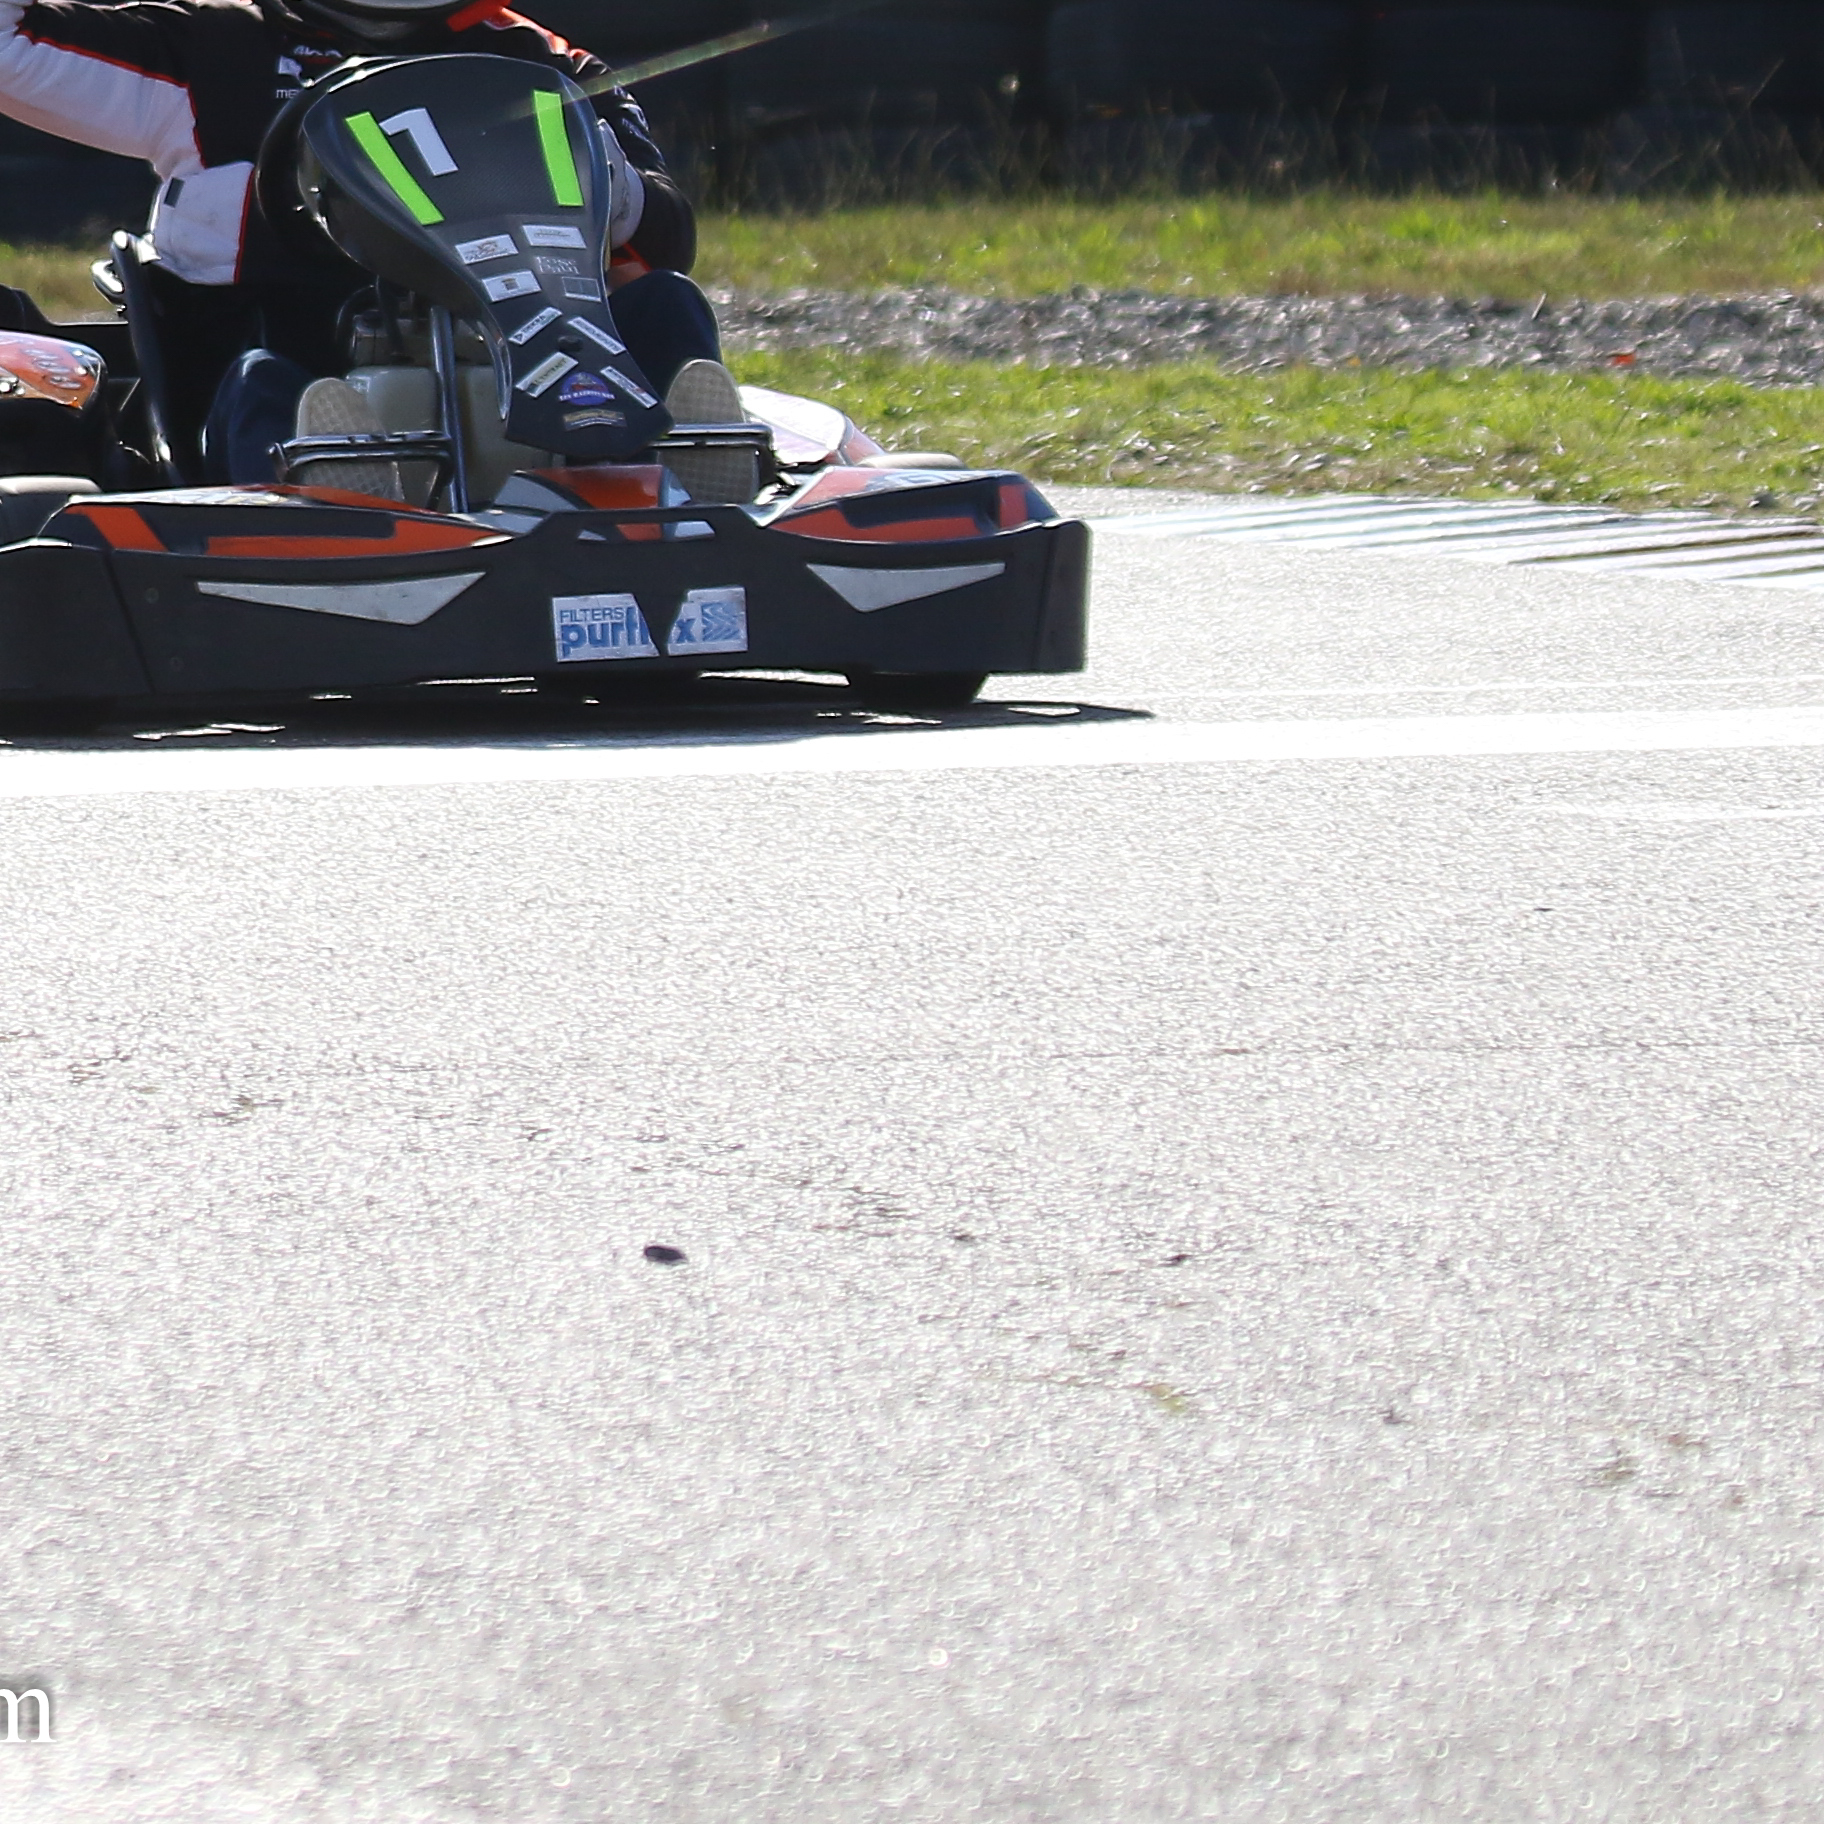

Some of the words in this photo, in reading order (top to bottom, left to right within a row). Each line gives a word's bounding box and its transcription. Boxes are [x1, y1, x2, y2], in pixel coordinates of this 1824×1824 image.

[379, 107, 459, 176] 1
[559, 606, 625, 623] FILTERS
[560, 606, 698, 658] purflx
